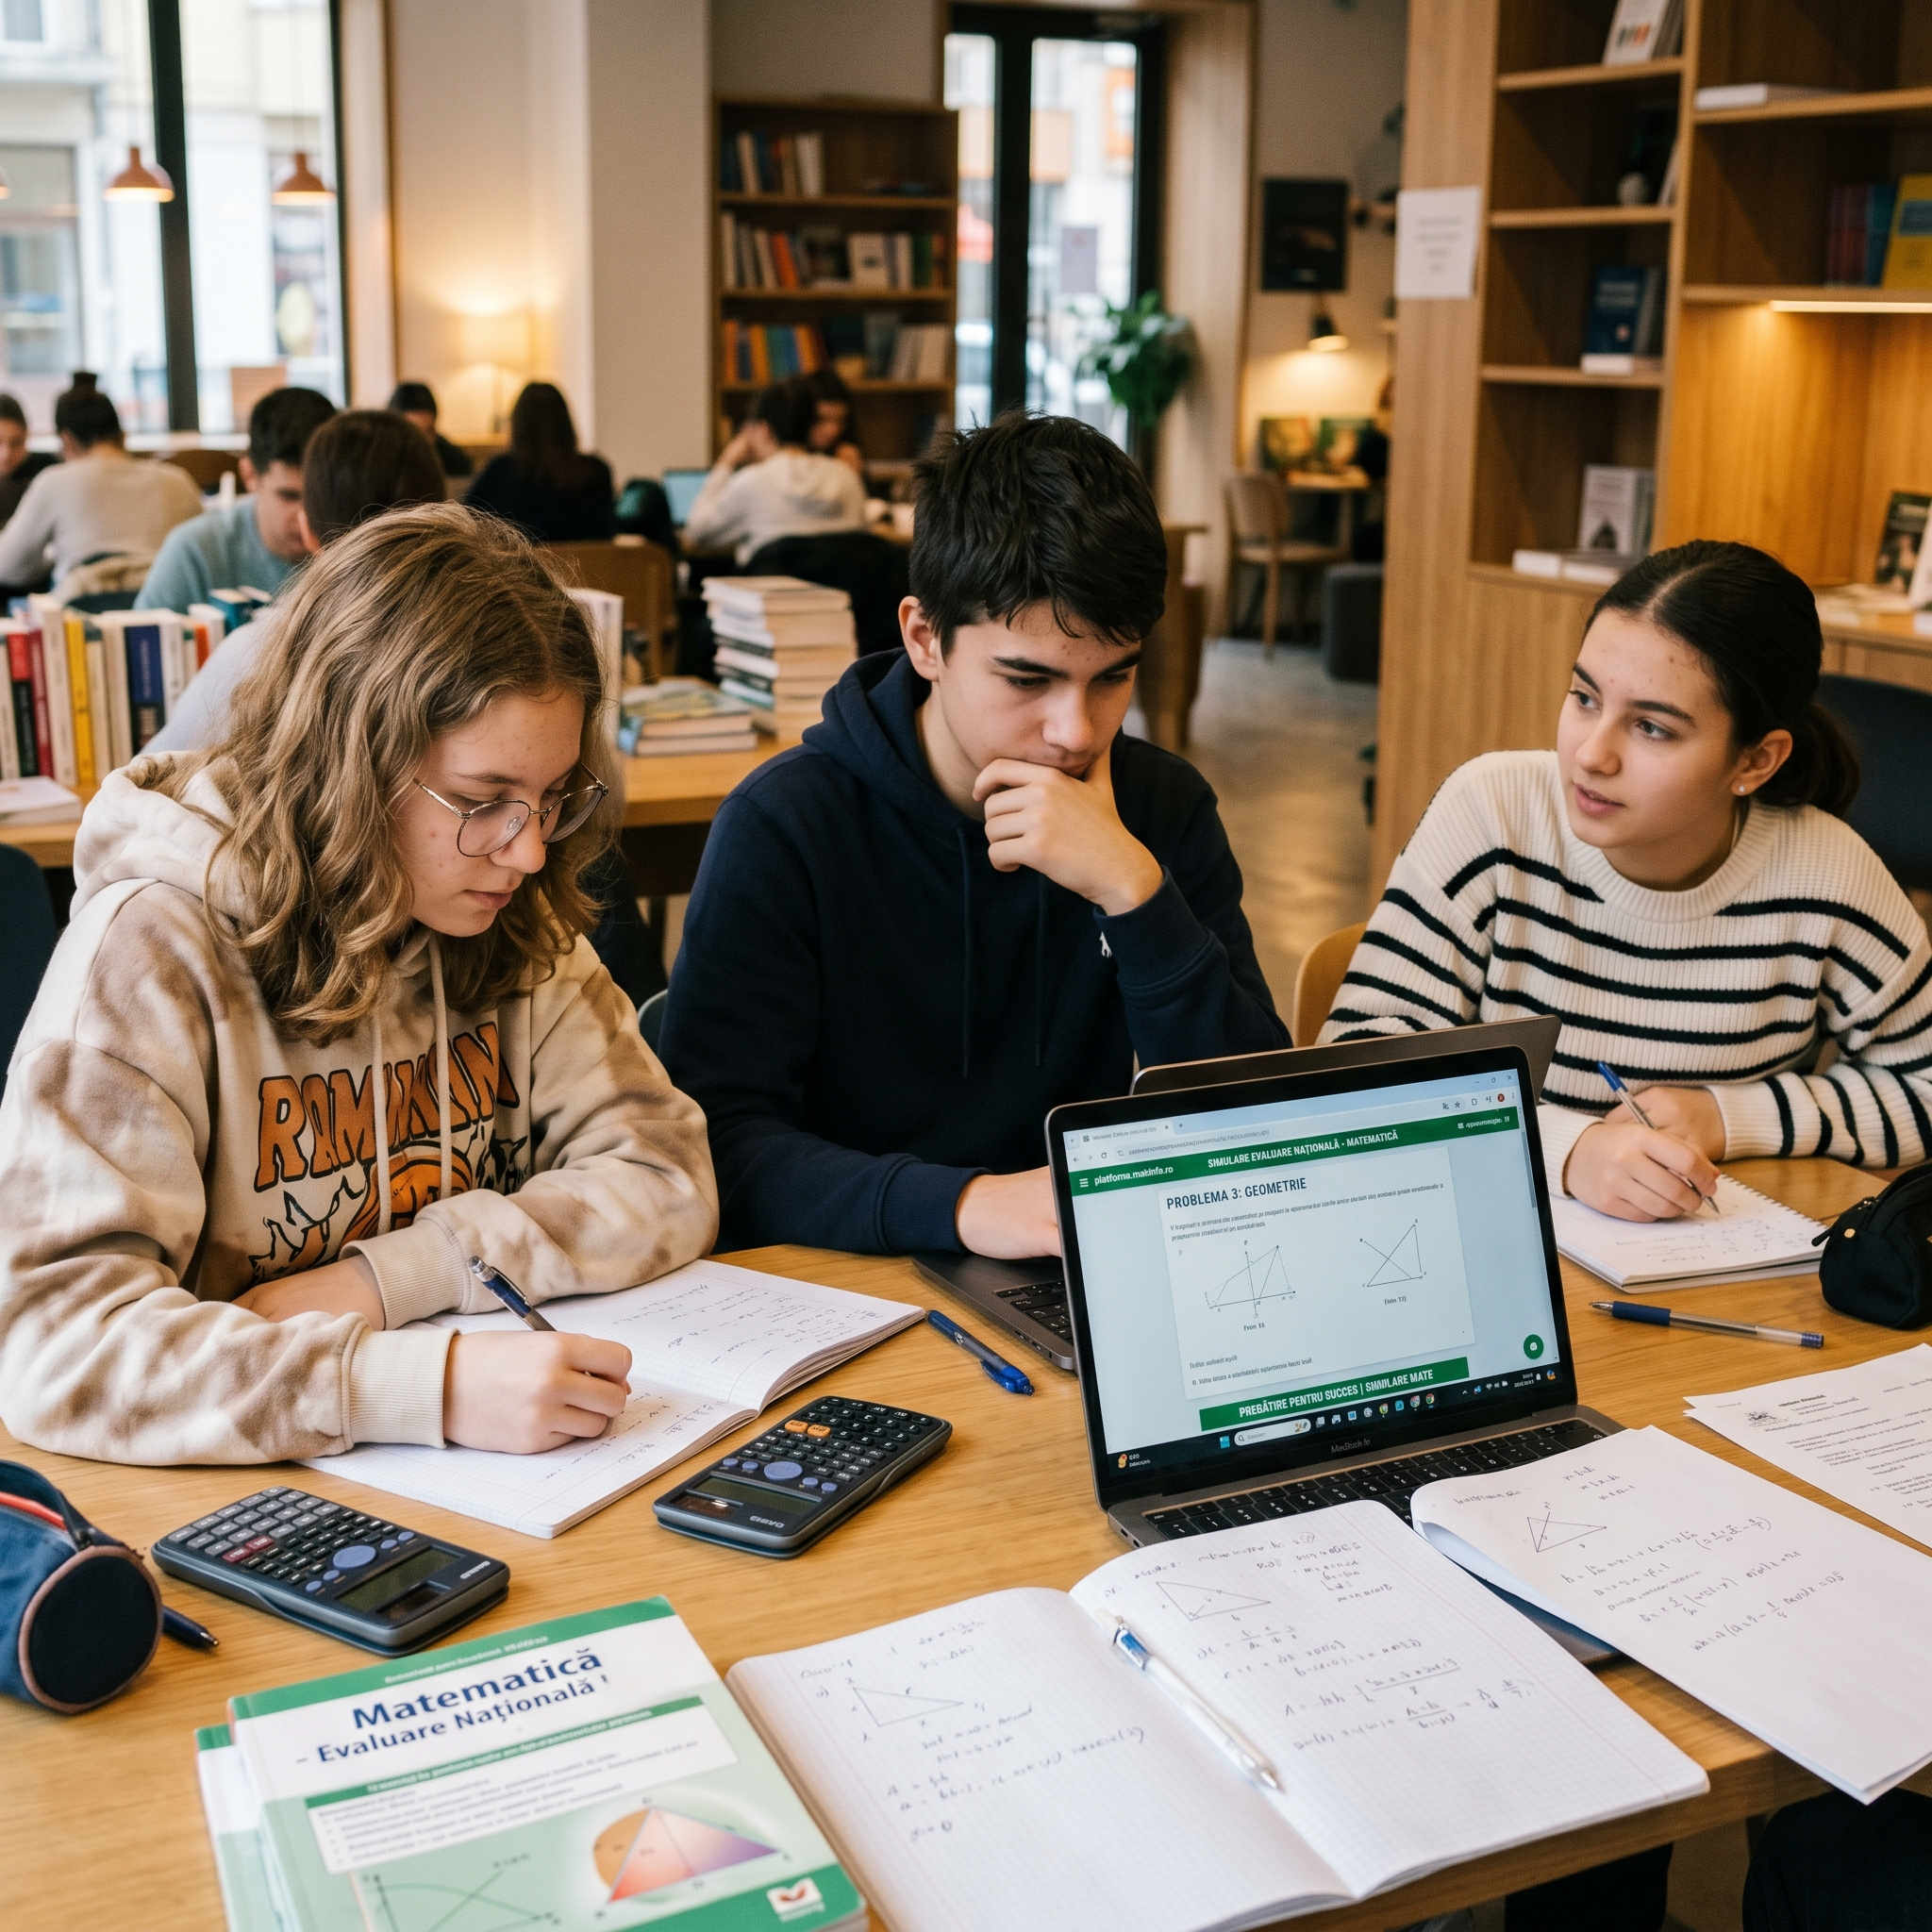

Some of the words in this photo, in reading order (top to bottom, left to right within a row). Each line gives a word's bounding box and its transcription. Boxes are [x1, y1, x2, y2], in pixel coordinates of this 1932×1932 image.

[1251, 1145, 1293, 1161] EVALUARE
[1346, 1128, 1399, 1147] MATEMATICĂ
[1166, 1190, 1229, 1209] PROBLEMA
[1231, 1188, 1242, 1200] 3:
[1244, 1177, 1307, 1197] GEOMETRIE
[1290, 1391, 1324, 1408] PENTRU
[1324, 1385, 1358, 1401] SUCCES
[1409, 1369, 1434, 1384] MATE
[351, 1647, 604, 1730] Matematică
[318, 1718, 448, 1764] Evaluare
